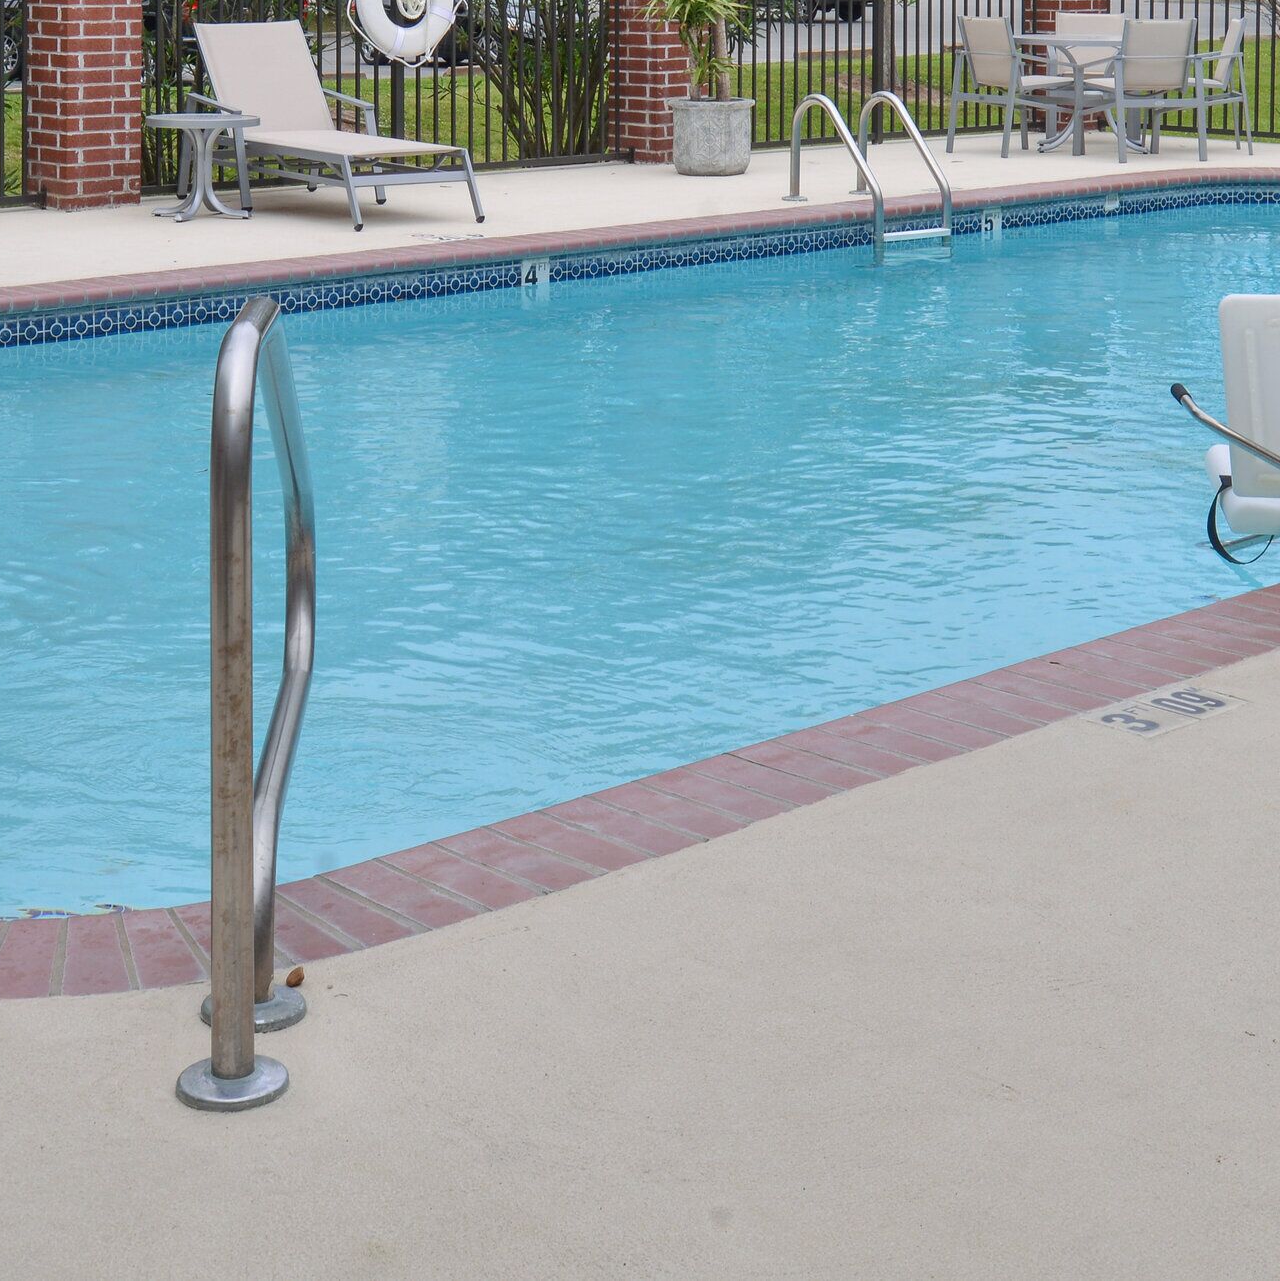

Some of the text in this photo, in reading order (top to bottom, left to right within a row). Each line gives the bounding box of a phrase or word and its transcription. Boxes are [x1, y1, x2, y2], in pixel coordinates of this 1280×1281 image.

[985, 217, 993, 231] 5
[525, 264, 537, 285] 4
[1102, 713, 1160, 732] 3
